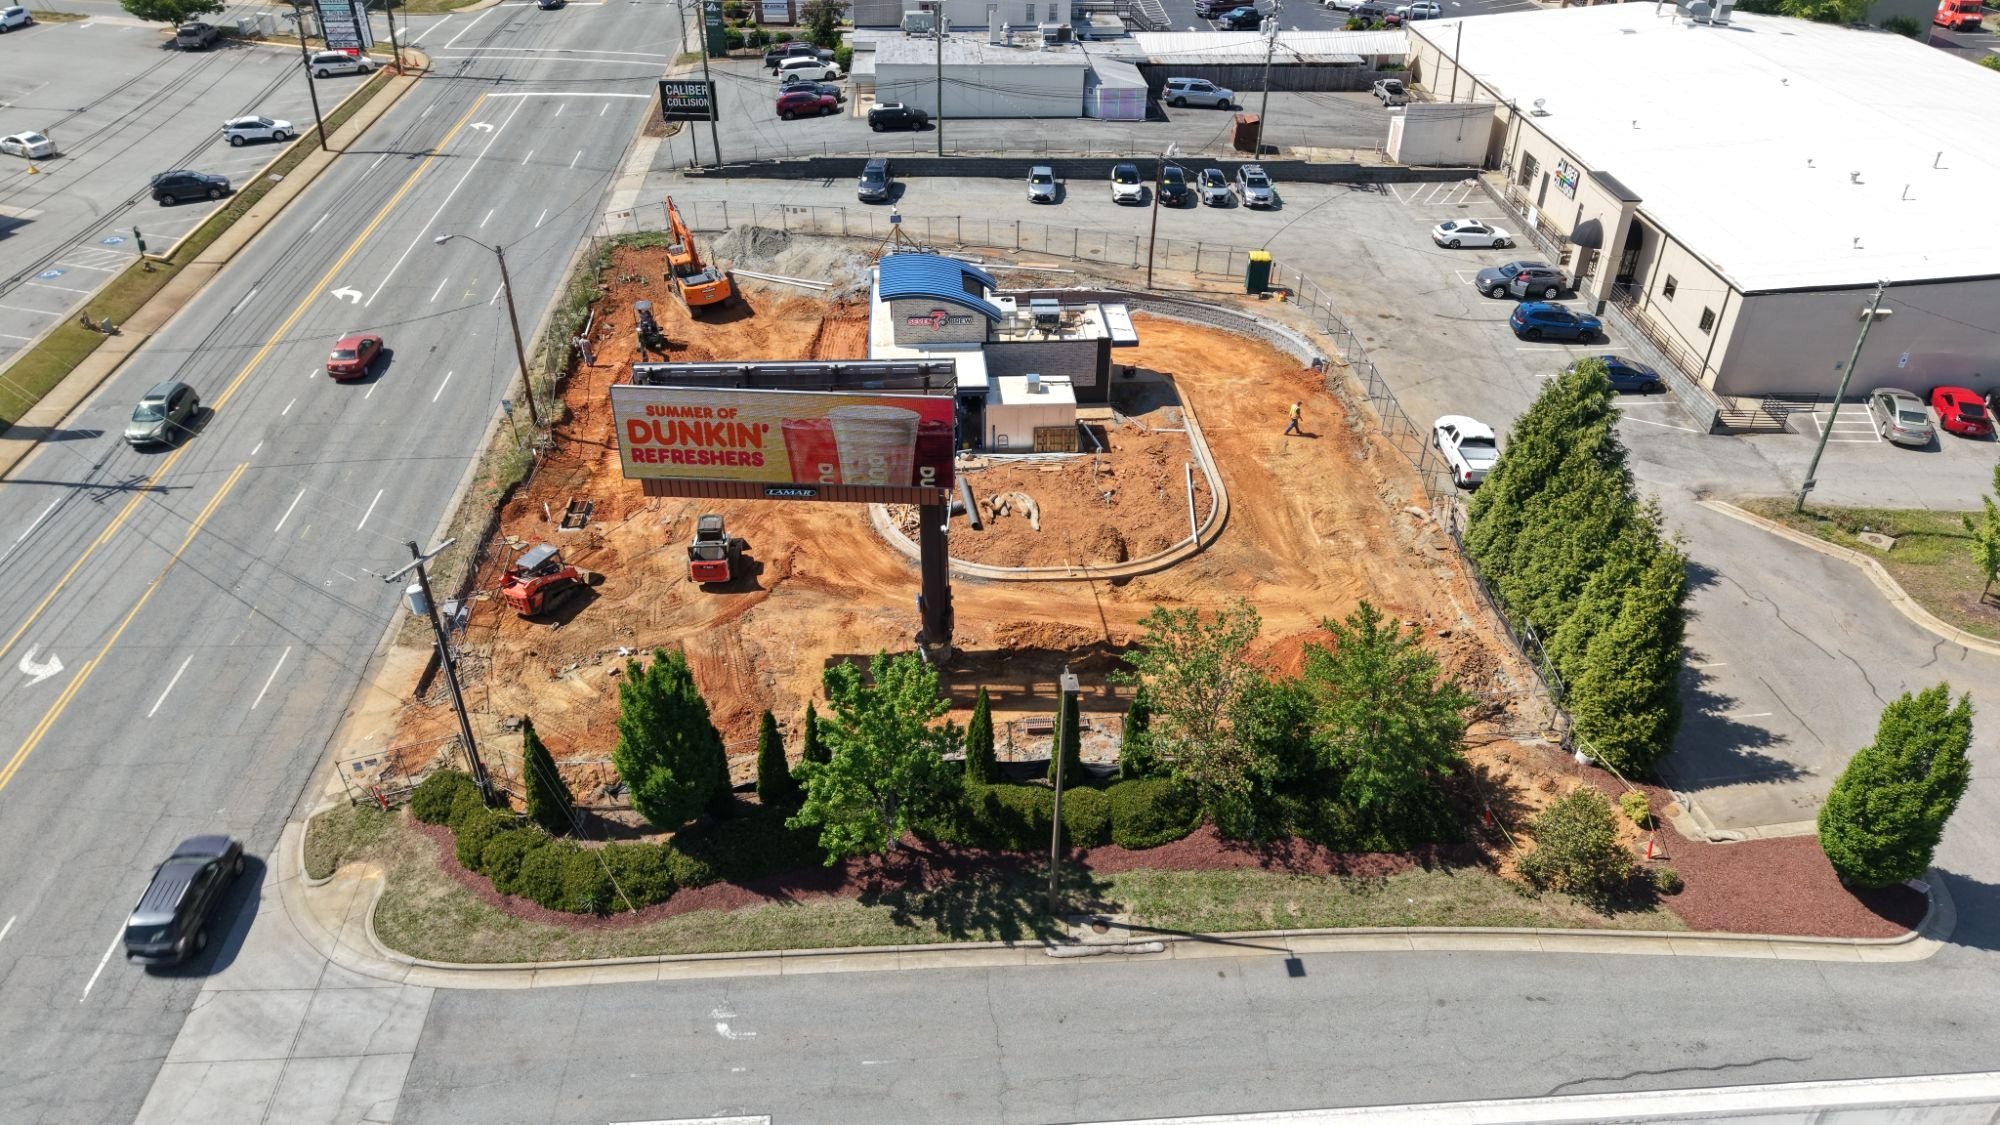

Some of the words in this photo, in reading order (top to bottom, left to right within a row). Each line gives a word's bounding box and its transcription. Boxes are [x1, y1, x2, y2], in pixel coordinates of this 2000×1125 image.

[665, 84, 709, 96] CALIBER
[667, 98, 710, 107] COLLISION
[646, 405, 713, 419] SUMMER
[717, 407, 738, 420] OF
[626, 419, 769, 449] DUNKIN'
[631, 448, 765, 467] REFRESHERS
